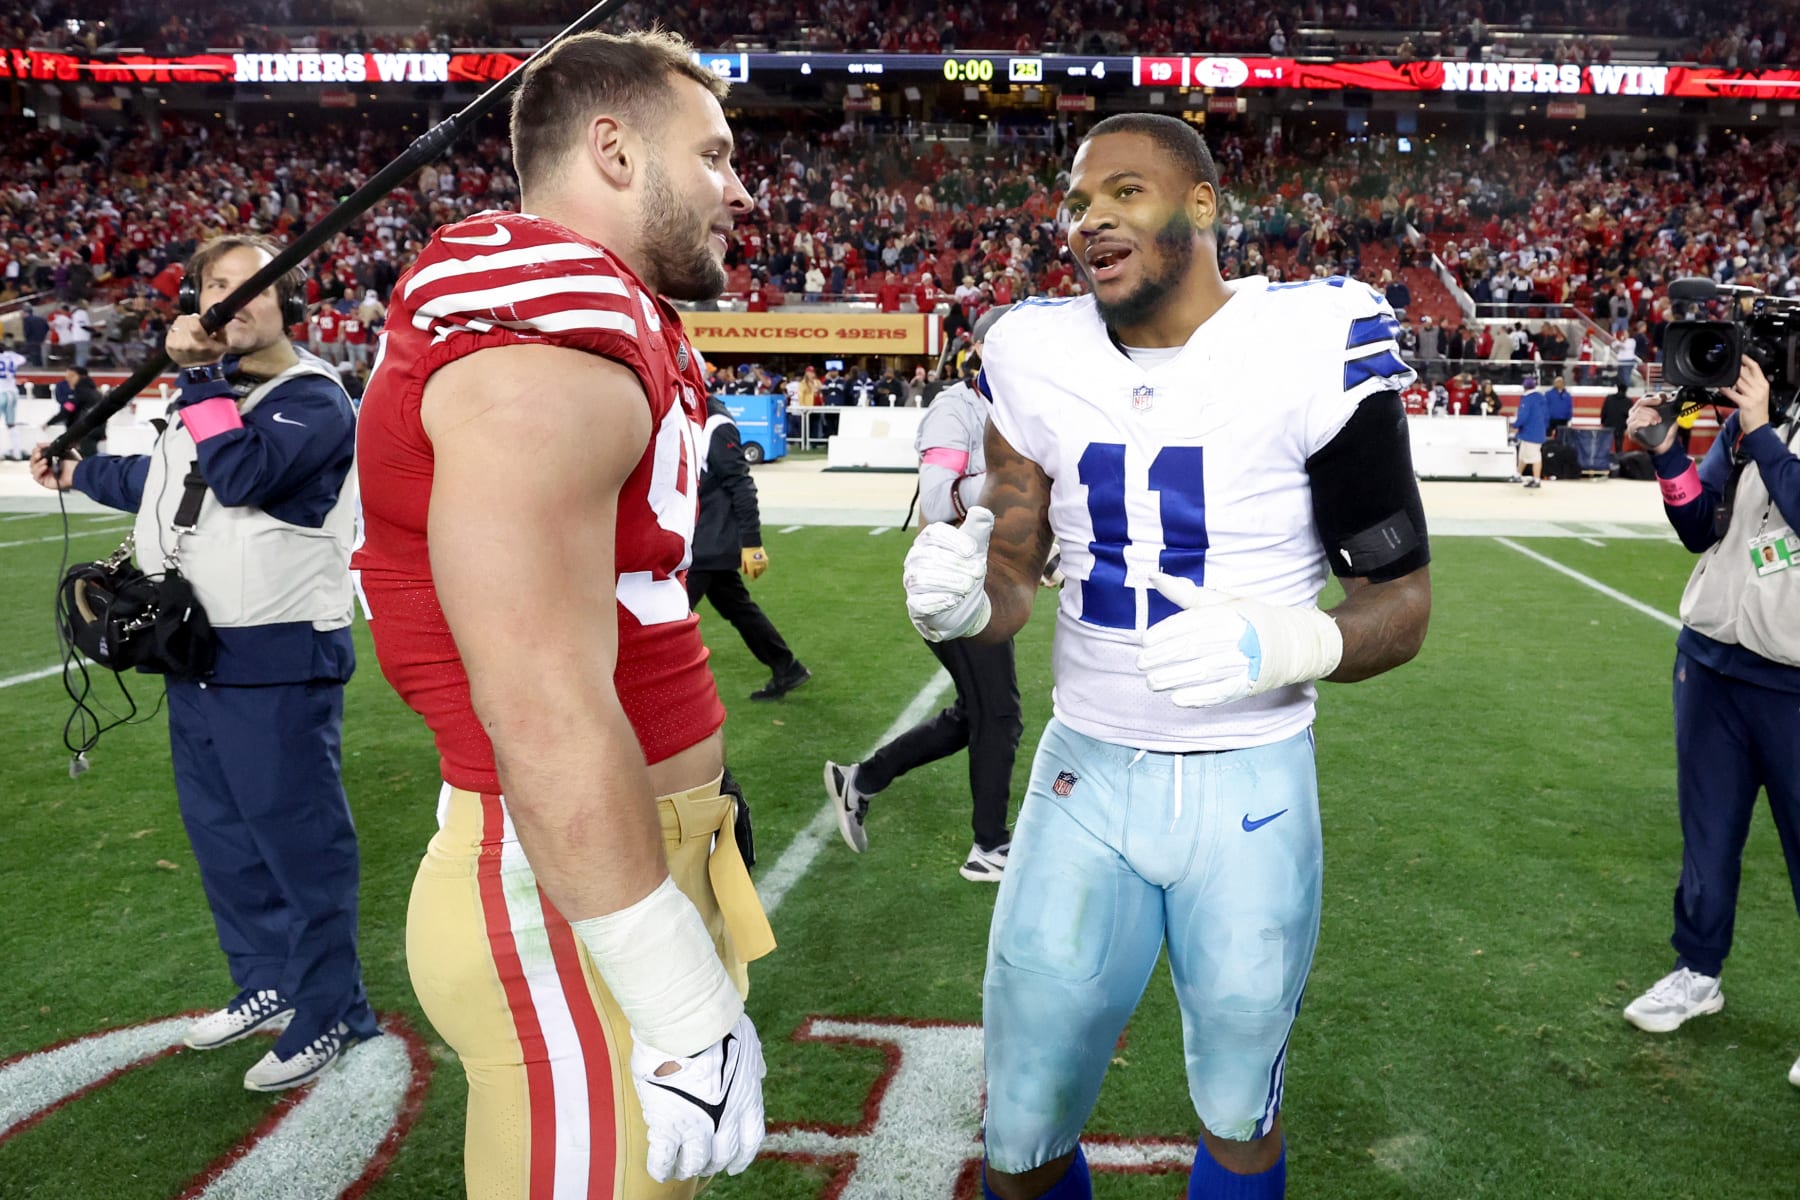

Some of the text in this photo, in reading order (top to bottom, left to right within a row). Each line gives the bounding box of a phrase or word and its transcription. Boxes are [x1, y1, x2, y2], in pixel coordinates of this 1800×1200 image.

[233, 53, 450, 82] NINERS WIN
[710, 59, 731, 77] 12
[943, 58, 993, 81] 0:00
[1015, 63, 1036, 77] 25
[1091, 61, 1105, 79] 4
[1150, 62, 1173, 80] 19
[1441, 62, 1669, 95] NINERS WIN
[693, 326, 908, 340] FRANCISCO 49ERS
[1078, 441, 1210, 630] 11
